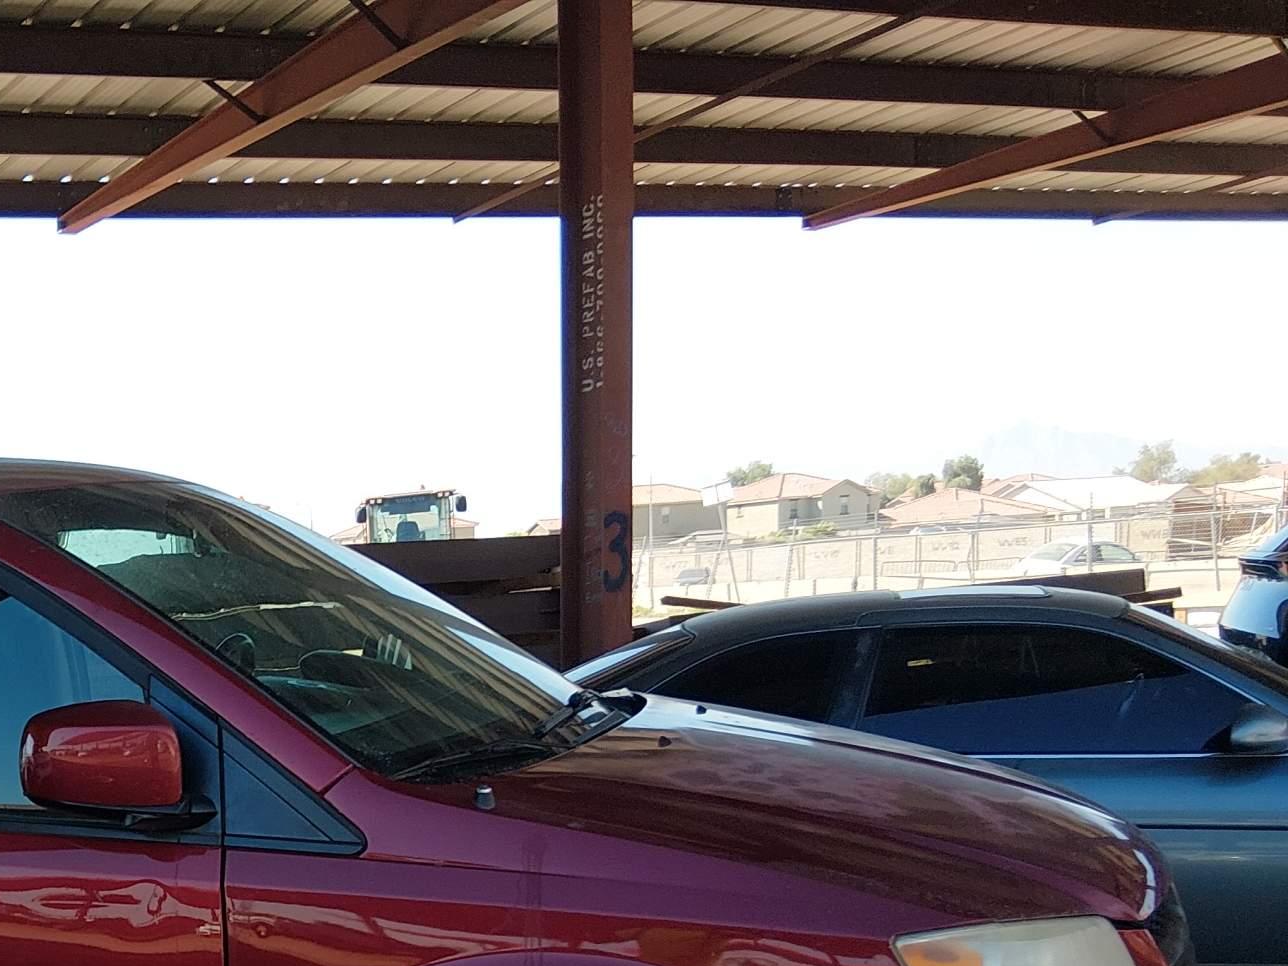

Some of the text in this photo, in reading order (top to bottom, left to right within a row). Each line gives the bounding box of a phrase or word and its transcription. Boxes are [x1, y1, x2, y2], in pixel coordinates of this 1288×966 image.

[582, 194, 595, 393] U.S. PREFAB INC.
[603, 511, 628, 593] 3
